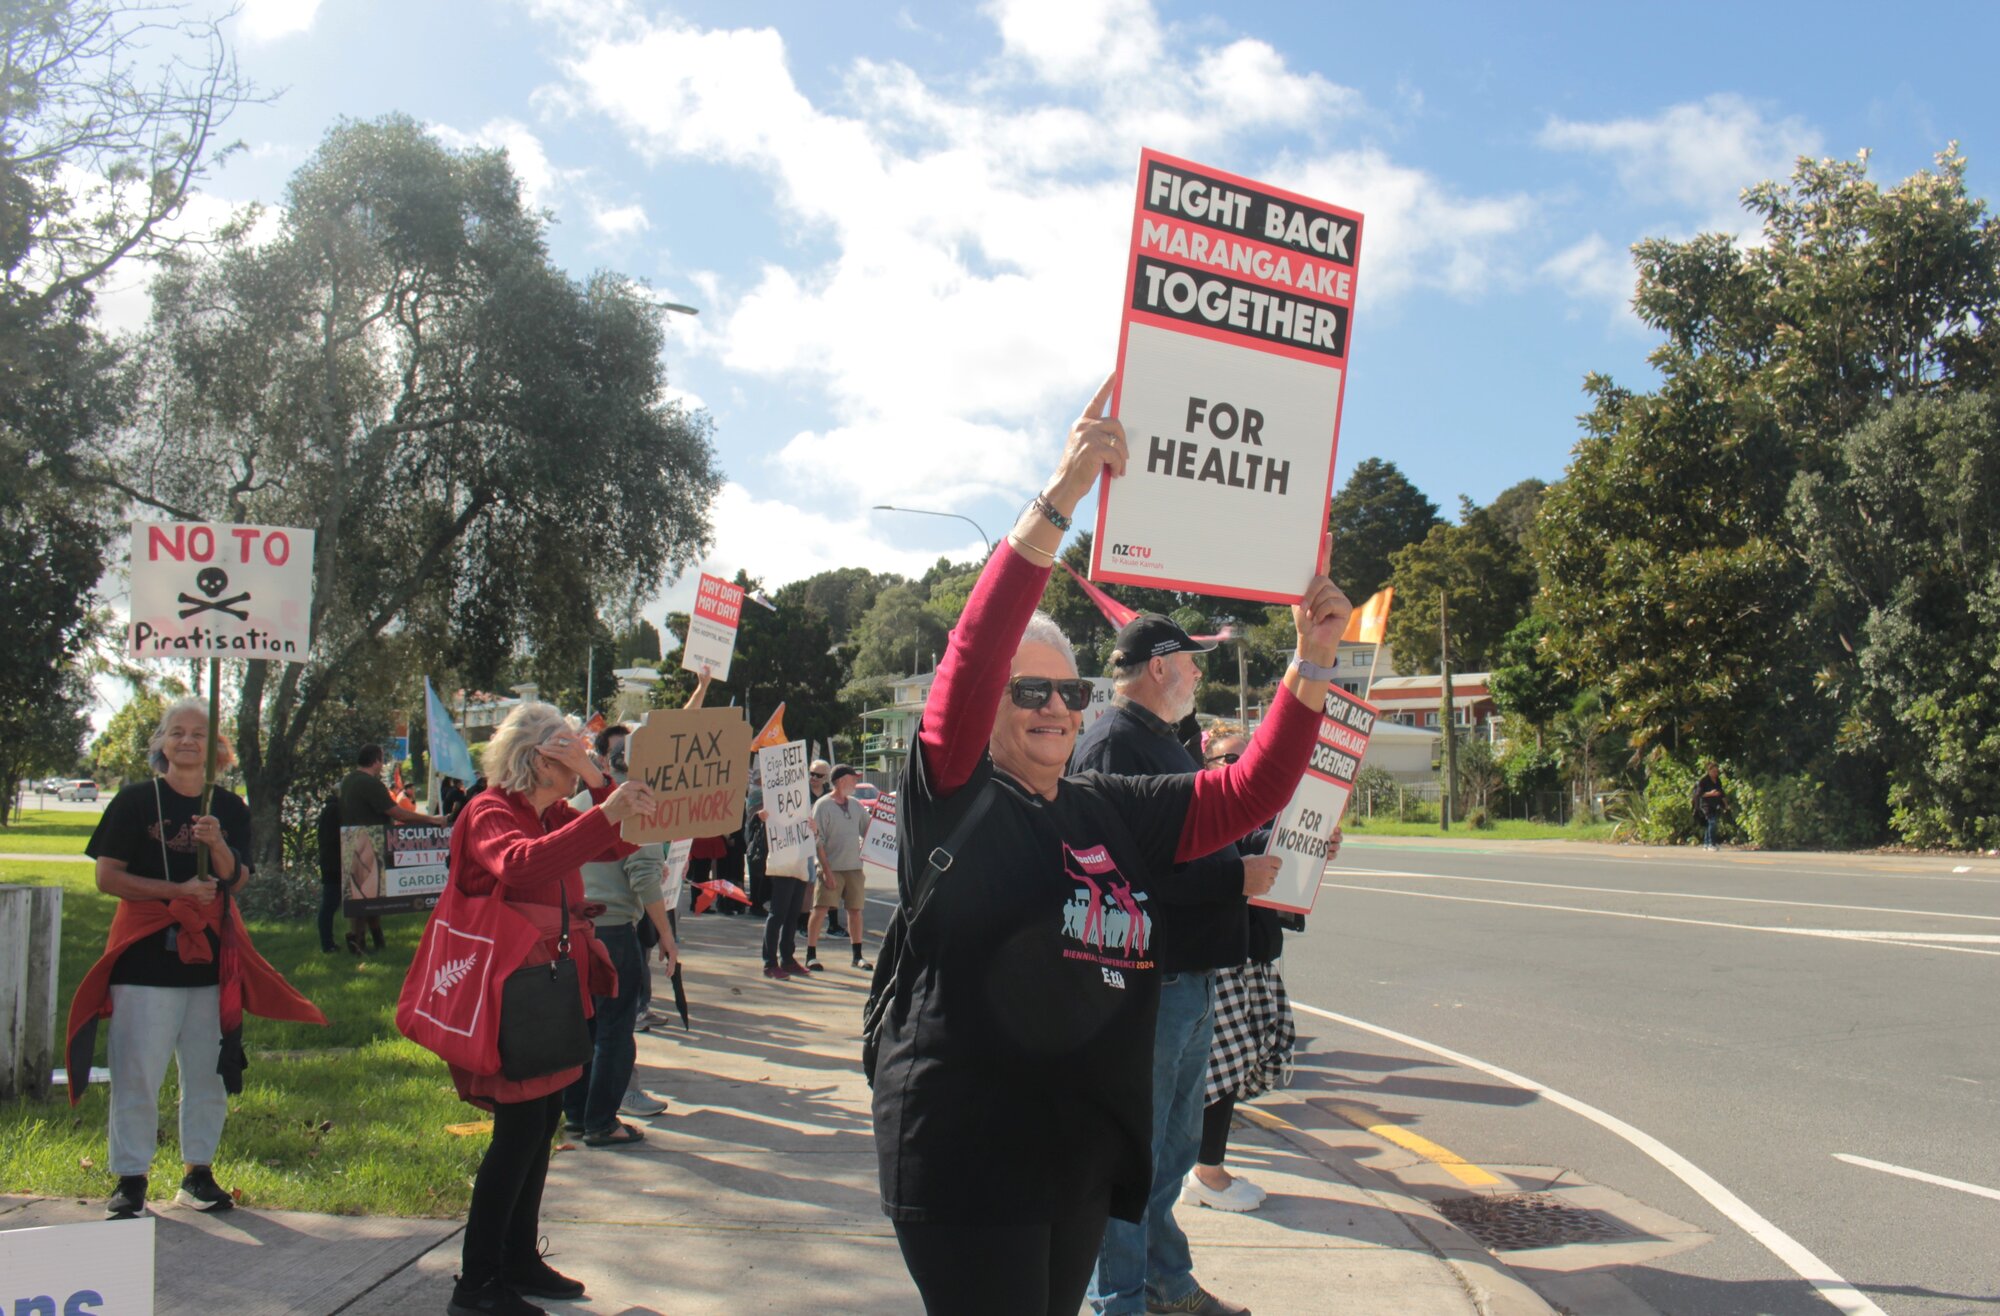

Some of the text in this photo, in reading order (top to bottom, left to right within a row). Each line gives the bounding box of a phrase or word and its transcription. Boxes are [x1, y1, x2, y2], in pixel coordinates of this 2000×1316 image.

[1150, 169, 1351, 259] FIGHT BACK
[1140, 219, 1350, 300] MARANGA AKE
[1145, 265, 1337, 349] TOGETHER
[1186, 397, 1264, 446] FOR
[1147, 436, 1290, 495] HEALTH
[148, 525, 290, 566] NO TO
[701, 578, 742, 605] MAY DAY!
[697, 595, 738, 622] MAY DAY!
[135, 622, 296, 653] Piratisation
[1092, 690, 1105, 703] HE
[1348, 705, 1374, 733] BACK
[670, 730, 723, 763] TAX
[1318, 721, 1366, 754] ARANGA AKE
[645, 760, 731, 791] WEALTH
[1310, 744, 1356, 780] OGETHER
[640, 789, 736, 831] NOT WORK
[778, 789, 803, 814] BAD
[398, 826, 451, 841] SCULPTUR
[1298, 809, 1322, 832] FOR
[1276, 827, 1329, 859] WORKERS
[398, 874, 449, 888] GARDEN
[1063, 949, 1099, 962] BIENNIAL
[1136, 960, 1154, 970] 2024
